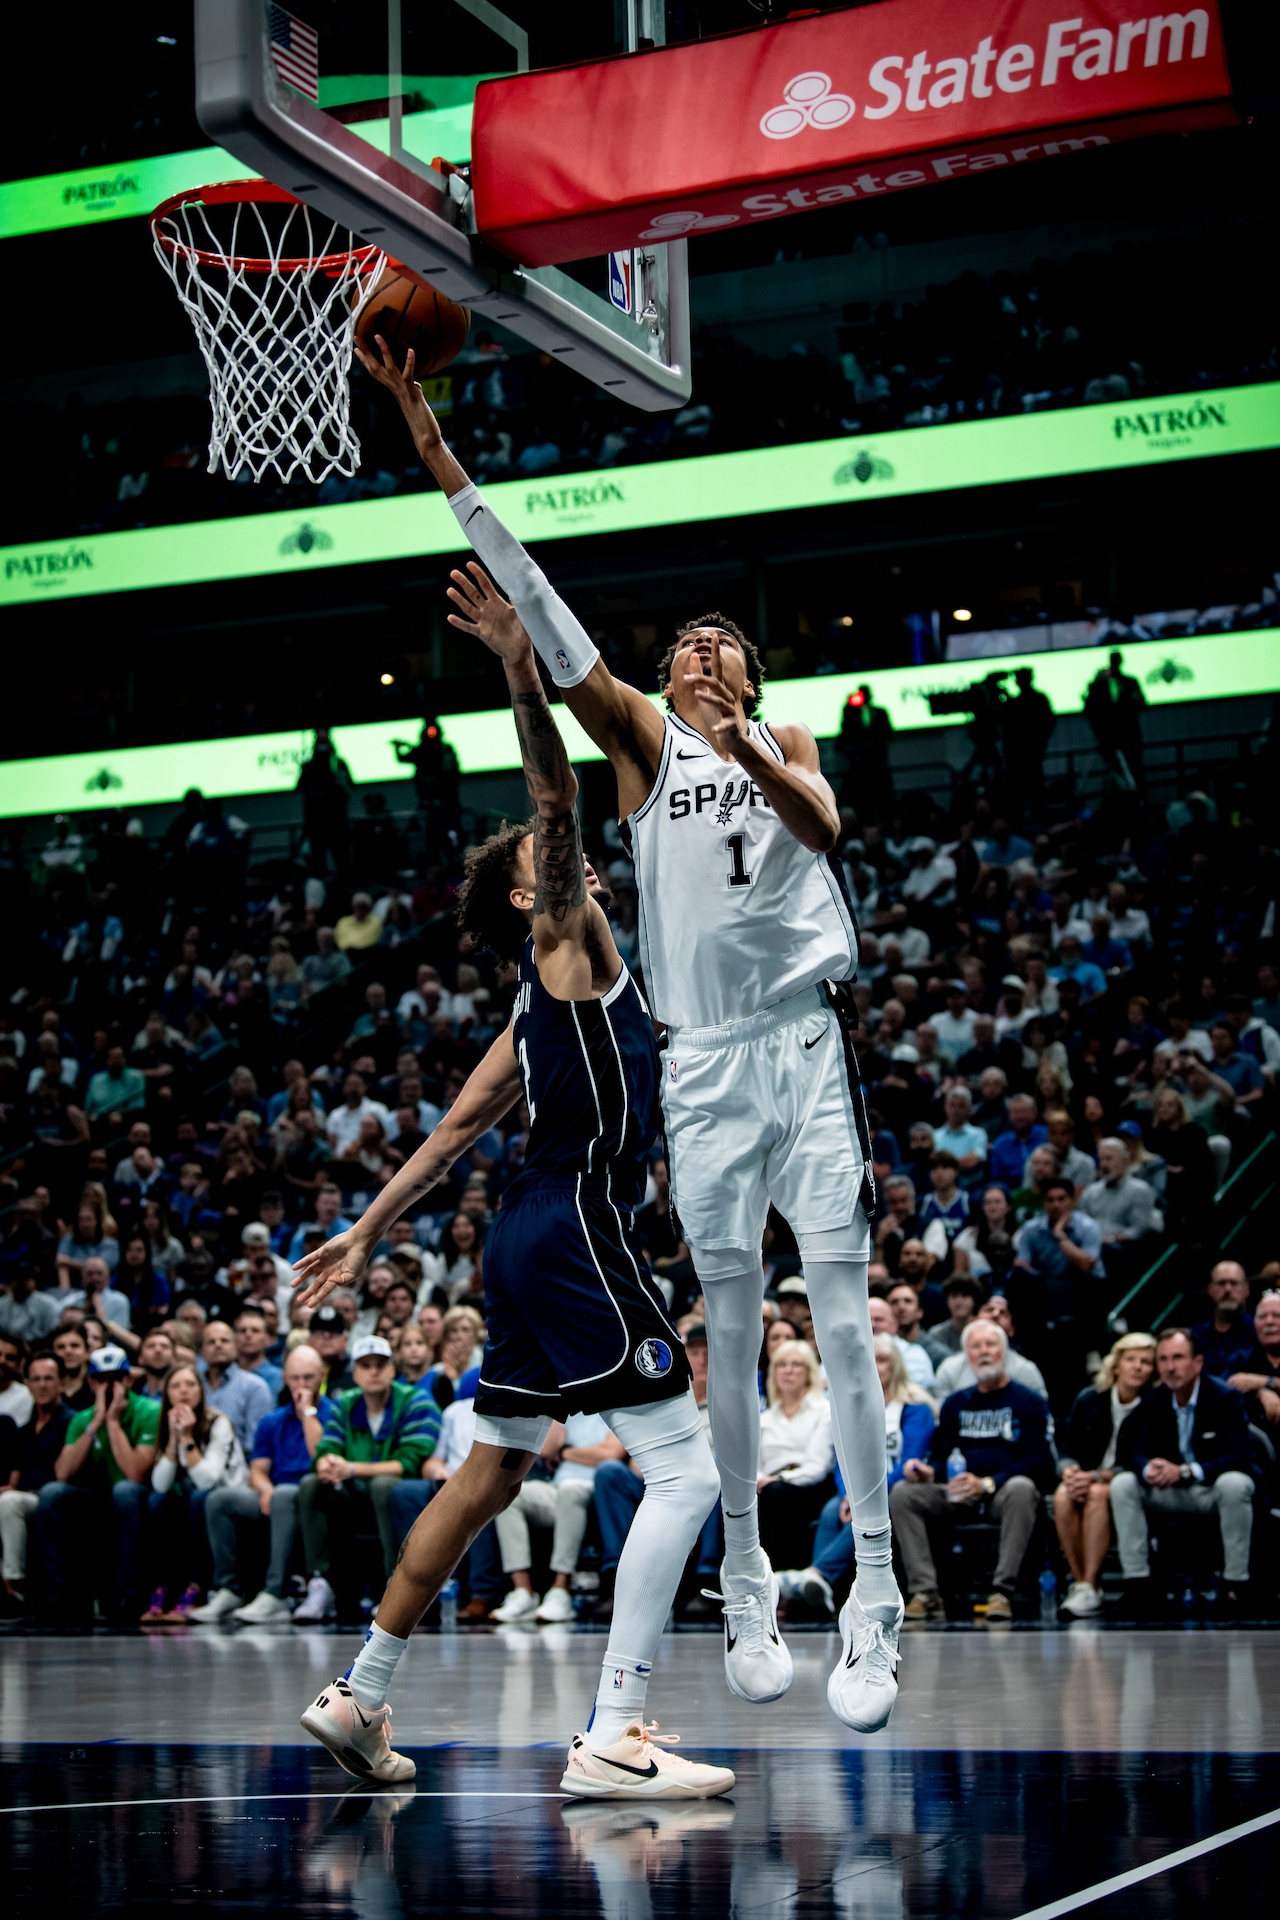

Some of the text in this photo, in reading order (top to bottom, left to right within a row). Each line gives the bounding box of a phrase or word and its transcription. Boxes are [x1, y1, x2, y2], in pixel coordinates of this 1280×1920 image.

[62, 173, 141, 205] PATRÓN
[612, 278, 624, 303] NBA
[1113, 399, 1230, 439] PATRÓN
[526, 477, 626, 513] PATRÓN
[5, 545, 94, 579] PATRÓN
[258, 749, 313, 768] PATR
[669, 781, 771, 827] SPUR
[725, 832, 753, 889] 1
